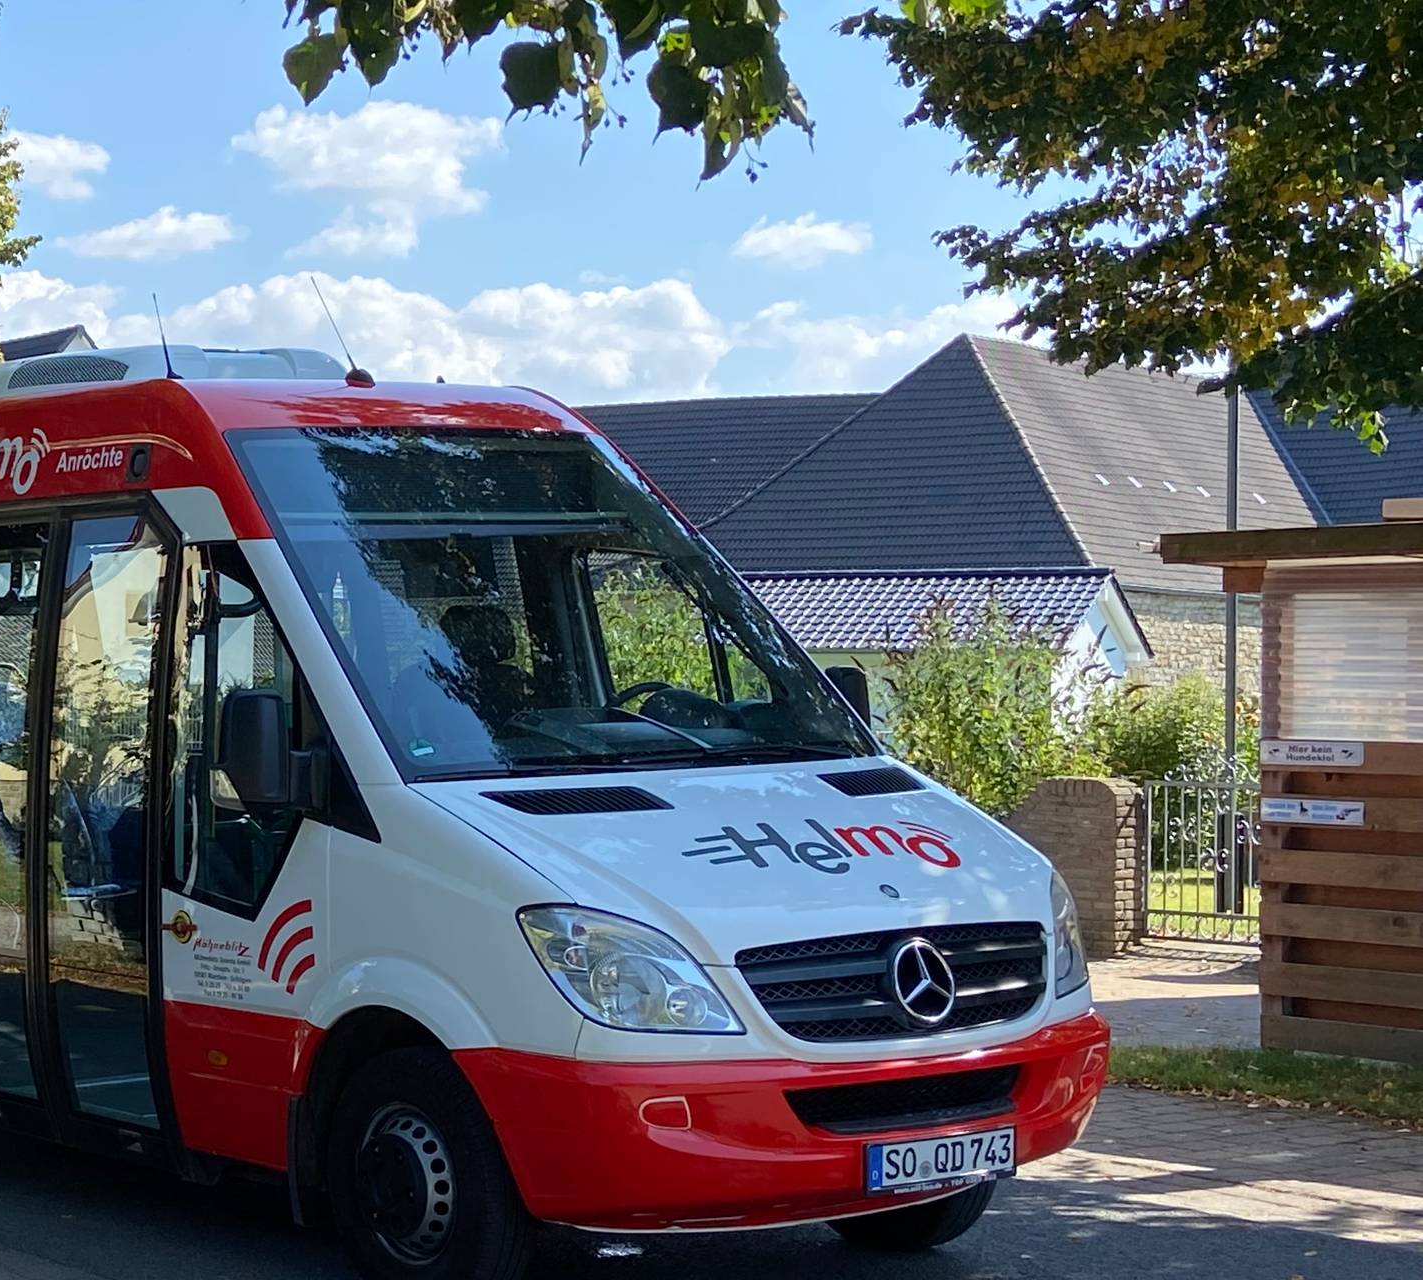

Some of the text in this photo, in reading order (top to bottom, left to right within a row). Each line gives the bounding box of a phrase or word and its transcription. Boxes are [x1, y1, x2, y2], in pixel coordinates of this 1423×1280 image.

[55, 446, 124, 473] Anröchte
[1285, 753, 1335, 763] Hundeklo!
[1288, 744, 1333, 754] Hier kein
[681, 818, 962, 875] Helmo
[884, 1146, 917, 1180] SO
[934, 1140, 965, 1174] QD
[970, 1133, 1011, 1169] 743
